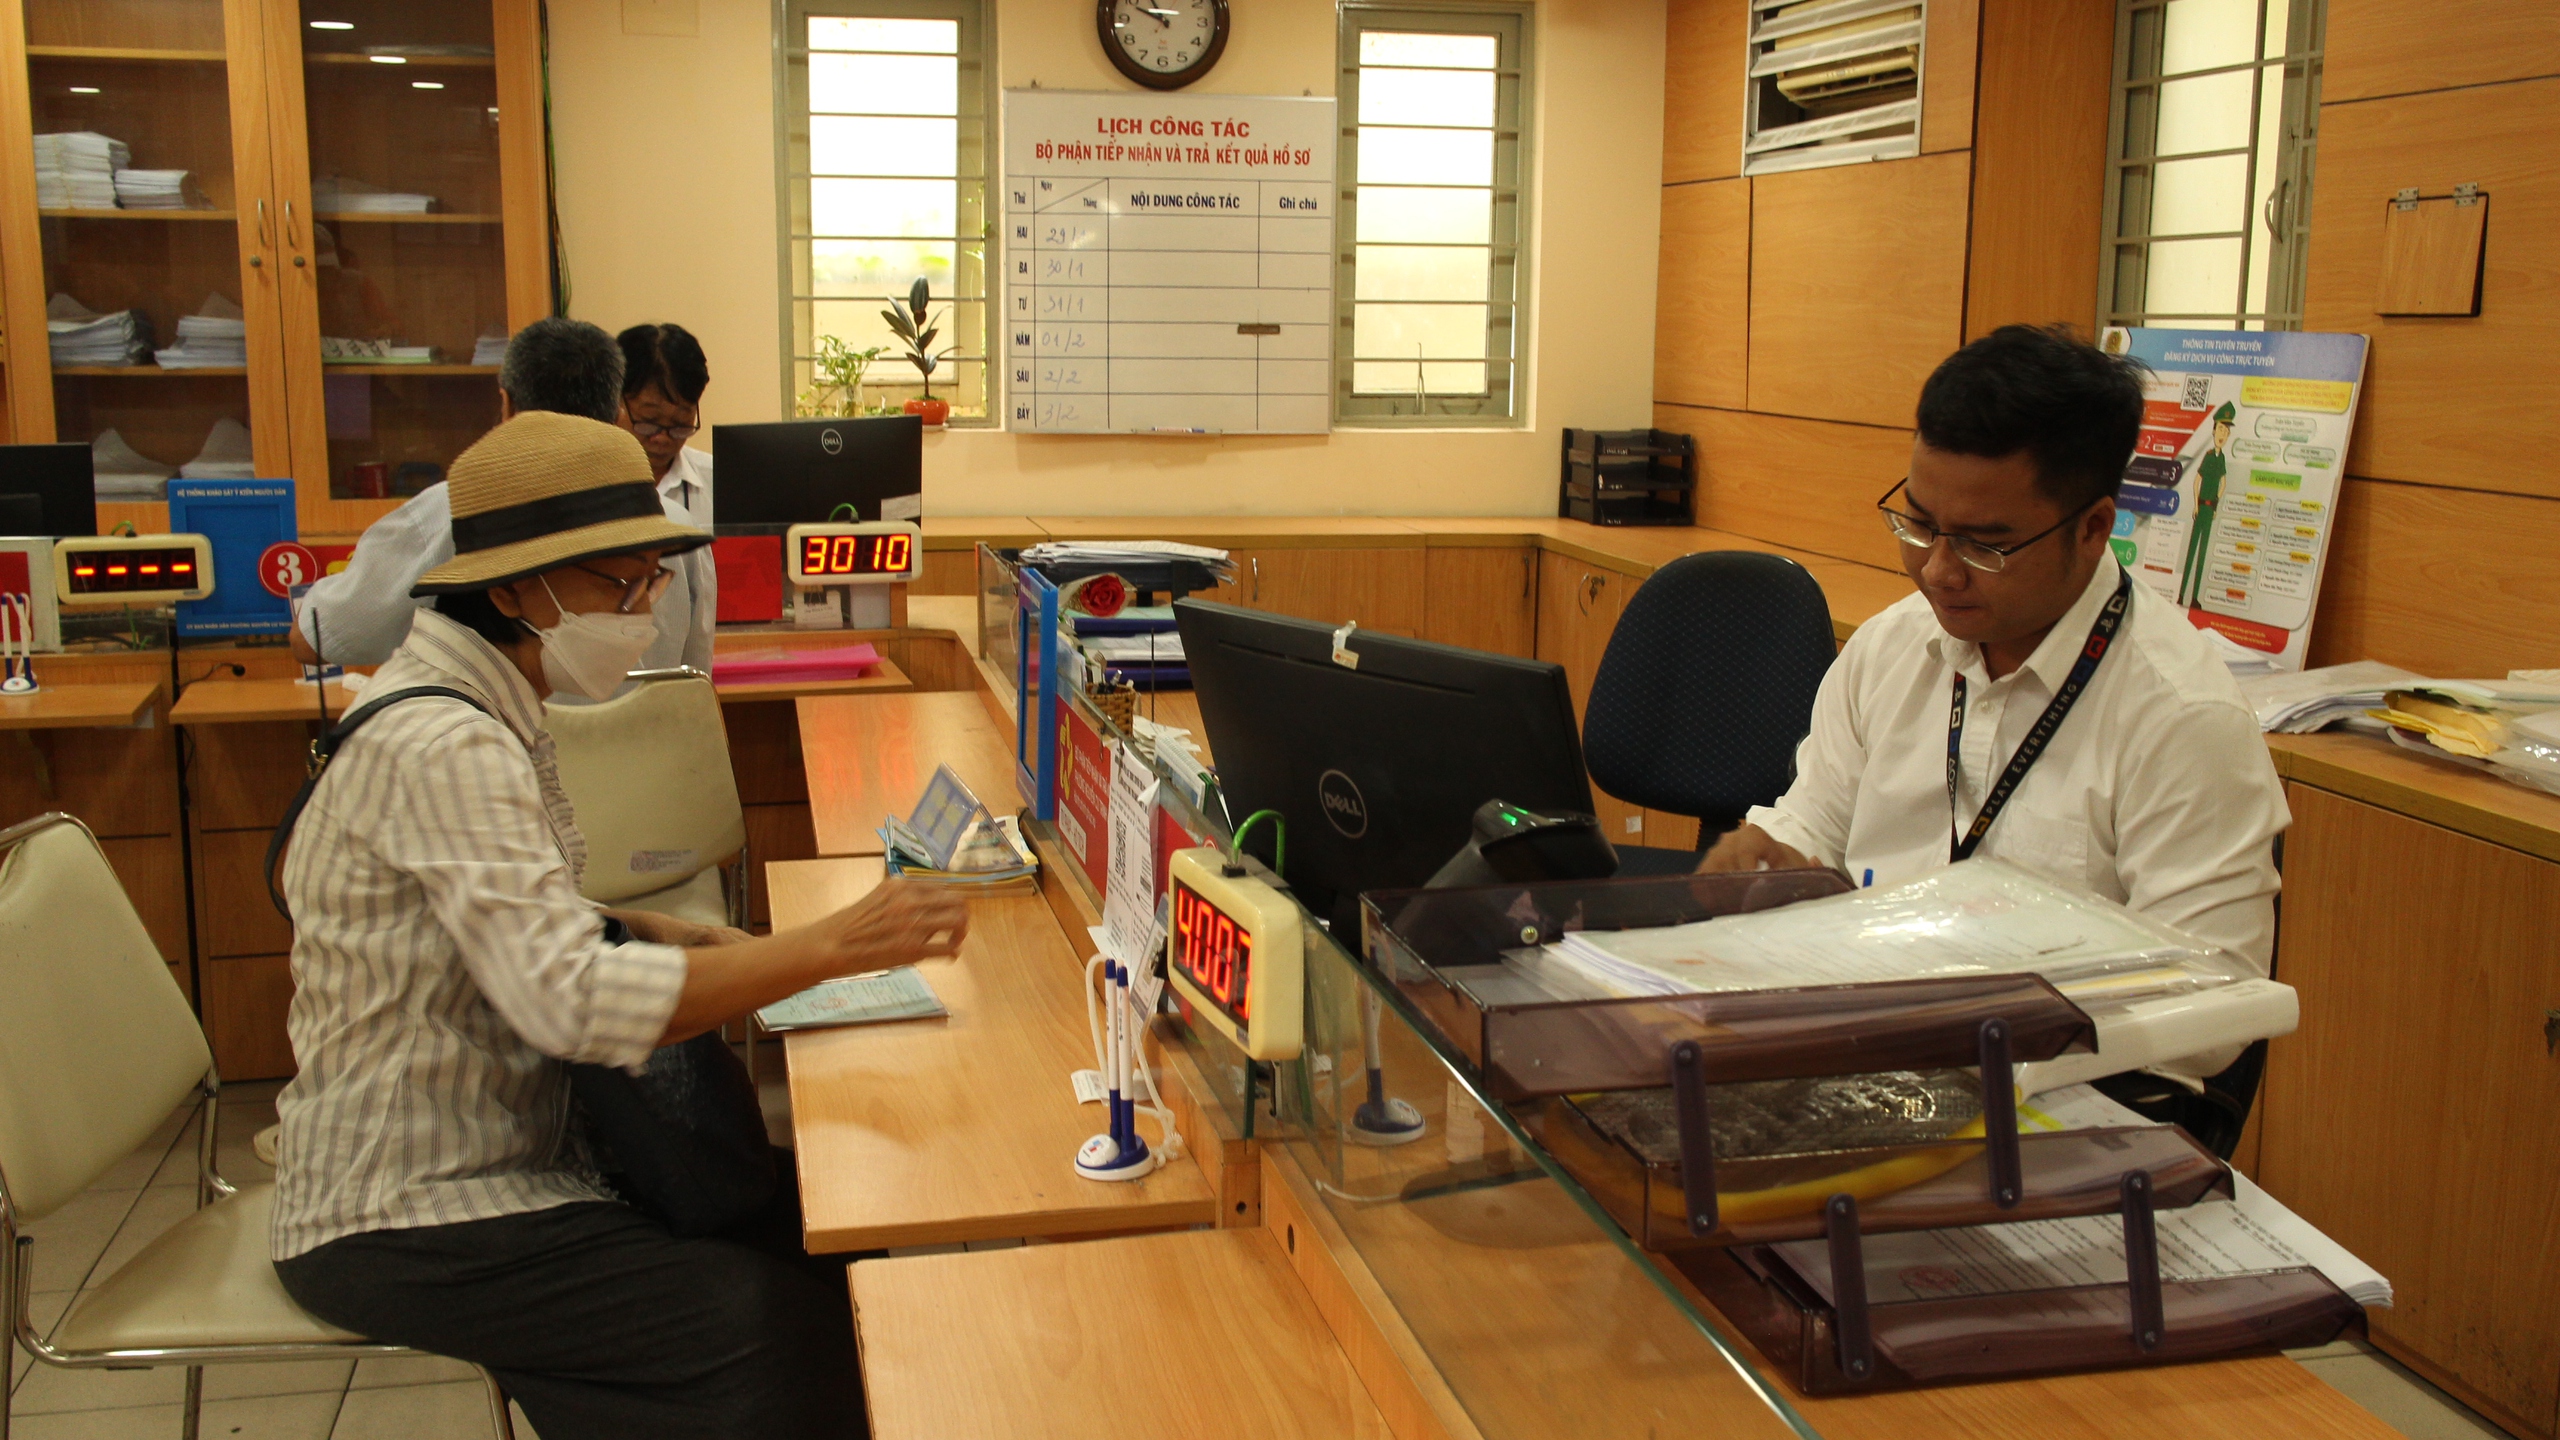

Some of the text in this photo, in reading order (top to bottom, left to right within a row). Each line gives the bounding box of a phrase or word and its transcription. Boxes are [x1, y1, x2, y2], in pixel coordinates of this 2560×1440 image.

[1097, 115, 1250, 138] LỊCH CÔNG TÁC
[1036, 138, 1311, 168] BỘ PHẬN TIẾP NHẬN VÀ TRẢ KẾT QUẢ HỒ SƠ
[1131, 191, 1240, 210] NỘI DUNG CÔNG TÁC
[1280, 196, 1317, 210] Ghi chú
[1016, 226, 1028, 239] HAI
[1019, 261, 1028, 275] BA
[1016, 367, 1030, 383] SÁU
[1017, 402, 1031, 420] BẢY
[804, 536, 909, 574] 3010
[277, 551, 303, 588] 3
[1986, 683, 2077, 816] PLAY EVERYTHING
[1324, 791, 1362, 816] DELL
[1177, 887, 1253, 1020] 4007
